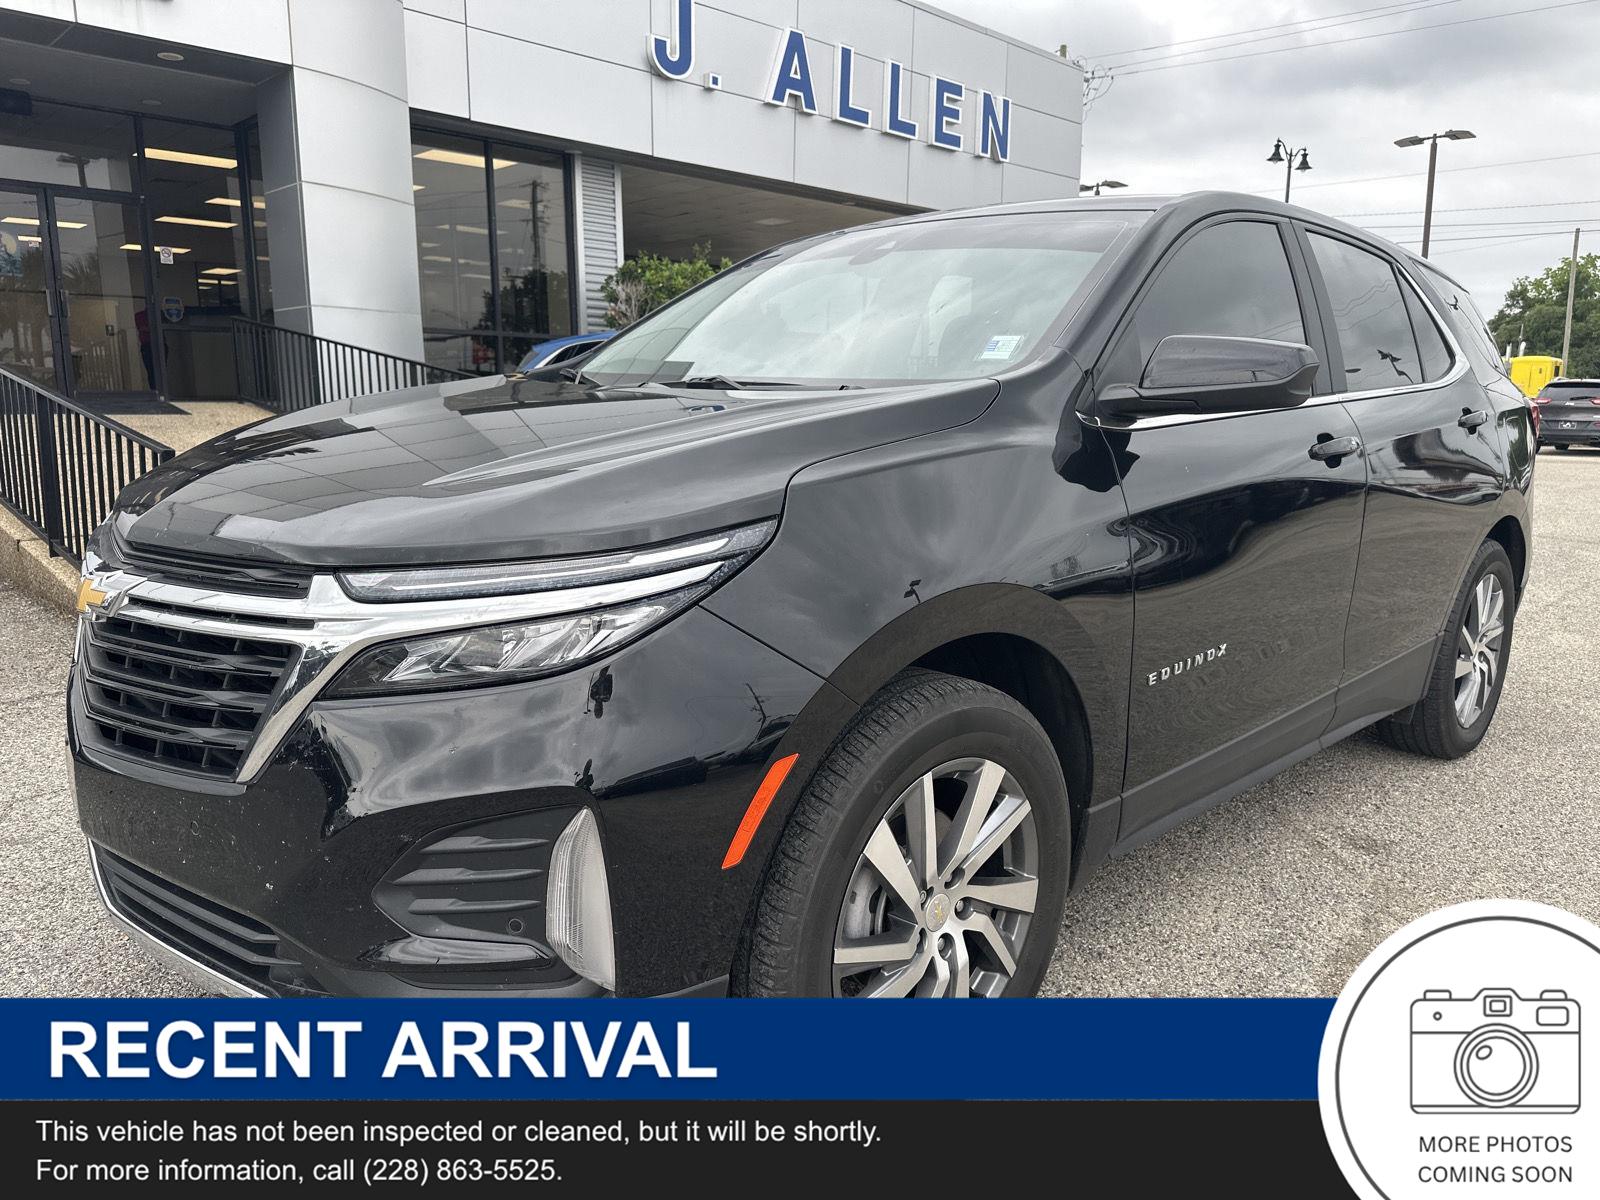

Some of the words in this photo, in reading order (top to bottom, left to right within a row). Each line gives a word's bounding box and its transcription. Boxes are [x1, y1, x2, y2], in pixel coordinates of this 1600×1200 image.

[648, 0, 722, 90] J.
[764, 27, 1012, 163] ALLEN
[1146, 643, 1227, 687] EQUINOX
